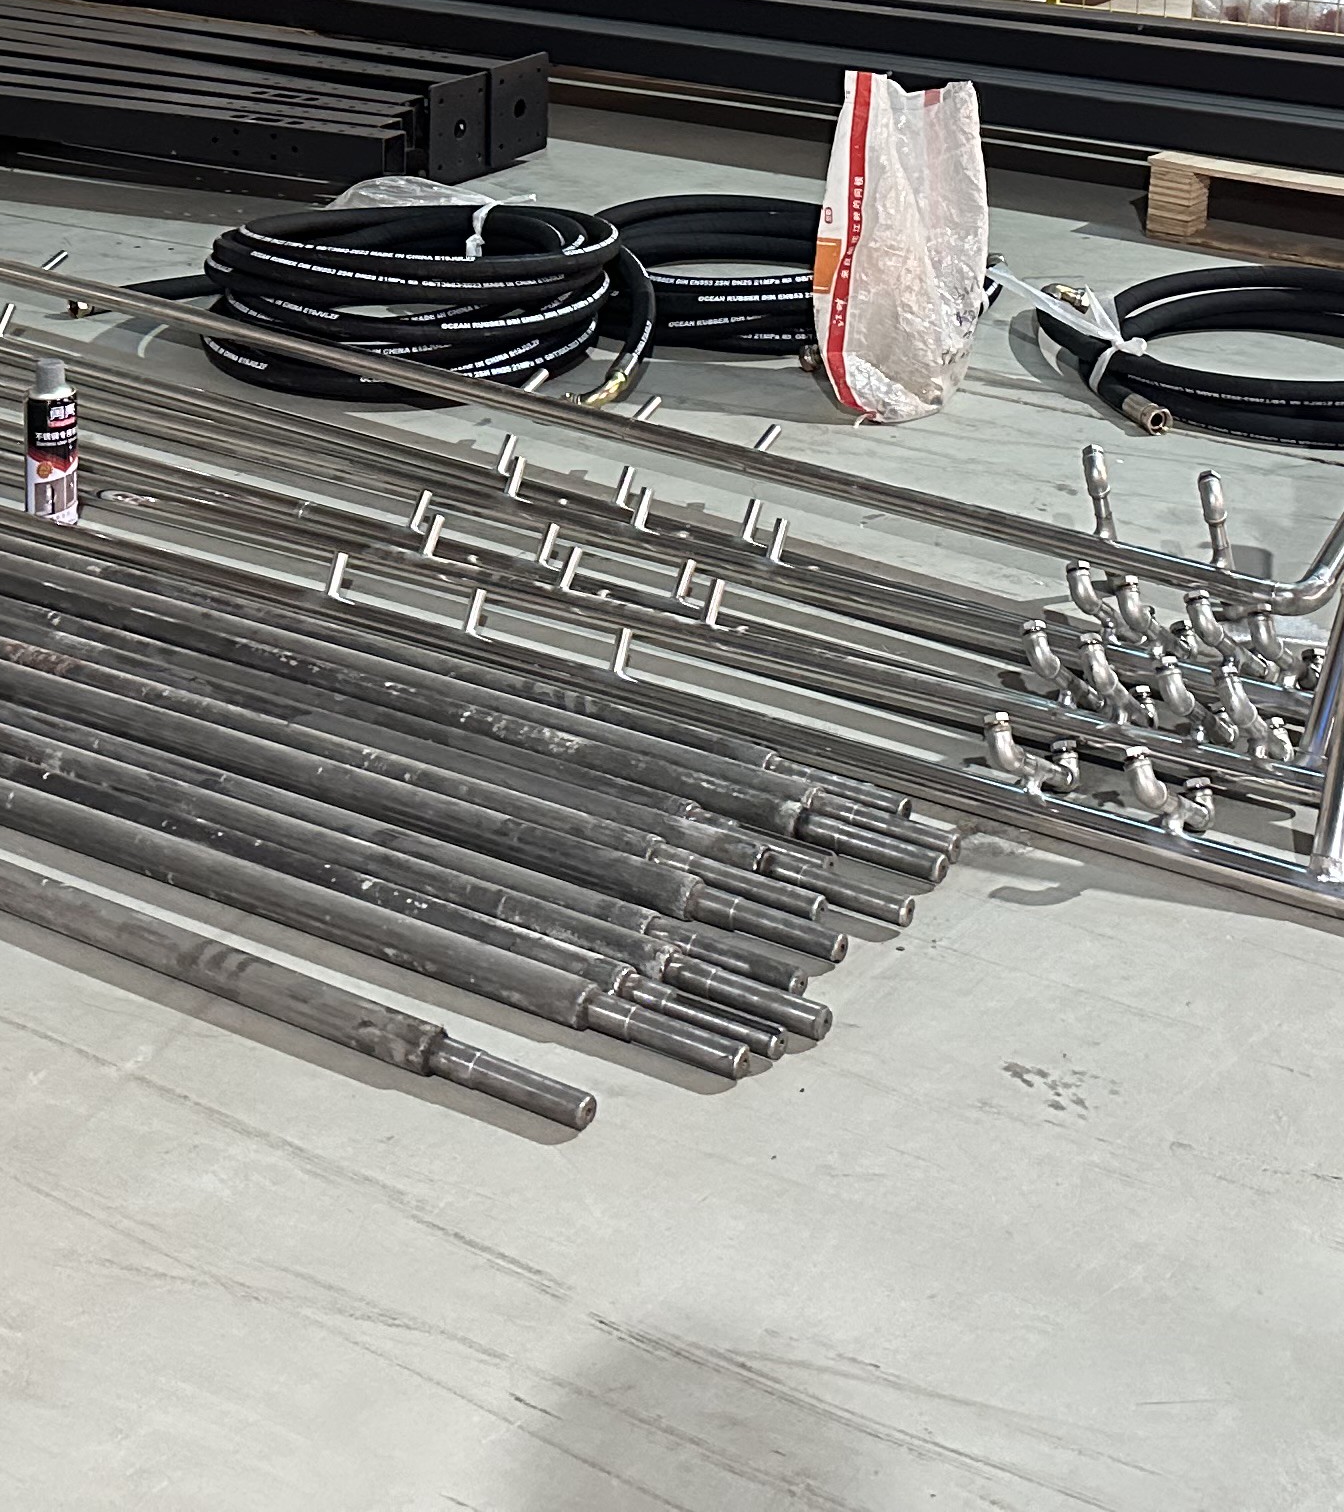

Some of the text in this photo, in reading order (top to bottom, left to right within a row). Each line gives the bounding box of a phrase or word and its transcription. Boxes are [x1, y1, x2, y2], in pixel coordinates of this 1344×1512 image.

[441, 321, 471, 330] OCEAN
[668, 320, 695, 328] OCEAN
[696, 317, 729, 327] RUBBER
